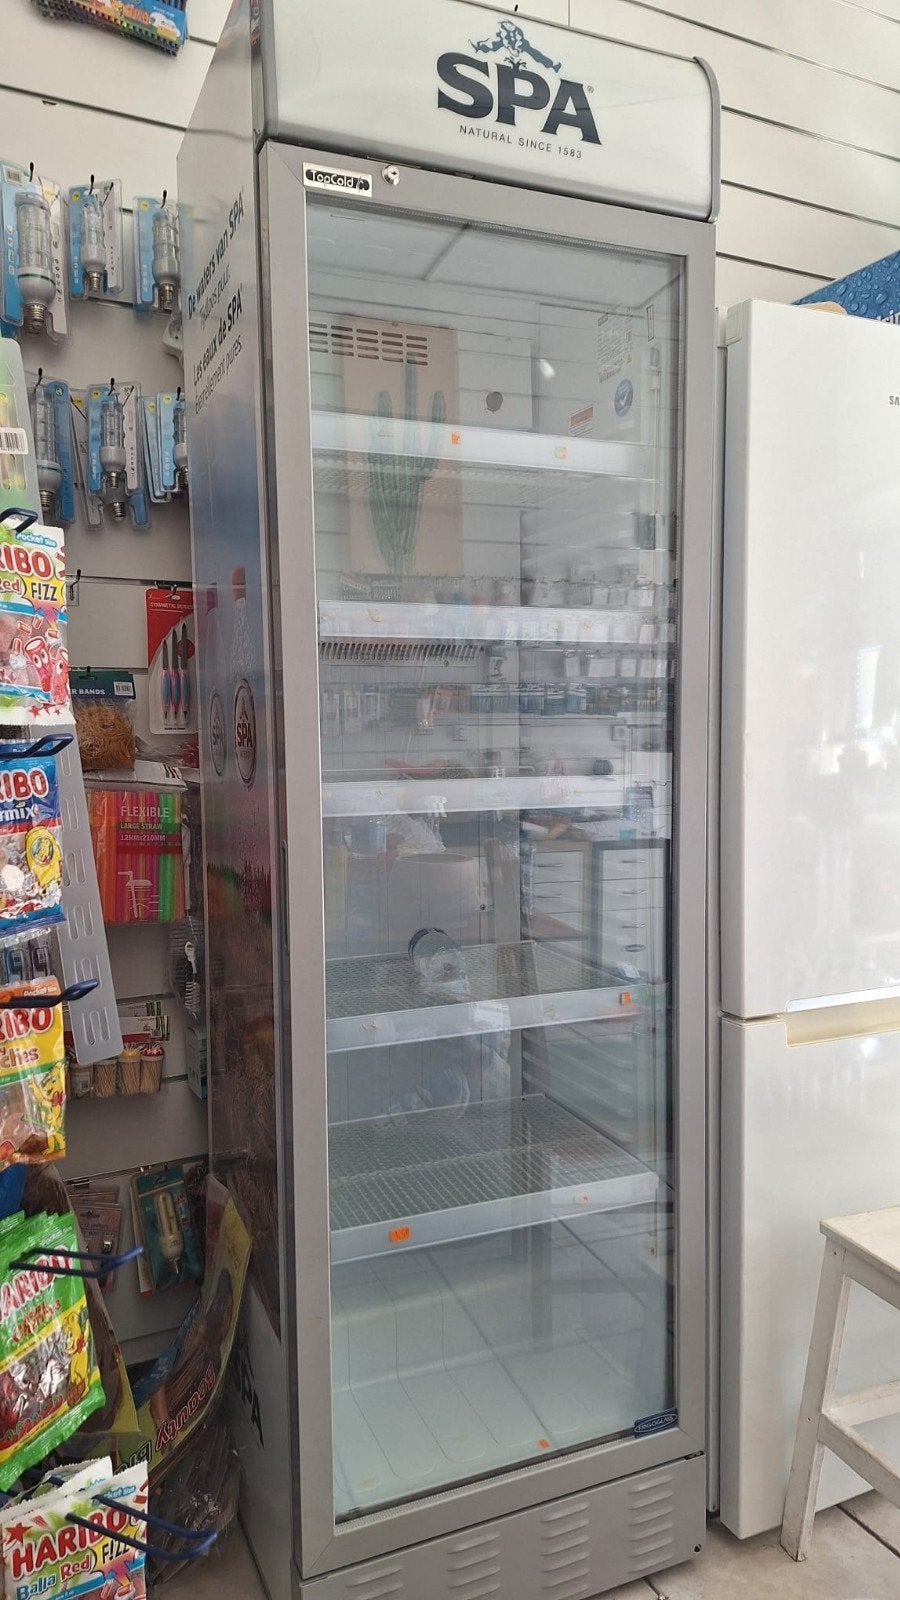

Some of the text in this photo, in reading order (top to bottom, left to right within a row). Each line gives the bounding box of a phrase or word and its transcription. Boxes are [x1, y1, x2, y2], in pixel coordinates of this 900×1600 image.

[437, 52, 602, 145] SPA
[459, 124, 583, 159] NATURAL SINCE 1583
[310, 169, 354, 188] TopCold
[188, 192, 244, 320] De waters van SPA
[193, 291, 243, 387] Les eaux de SPA
[225, 334, 243, 375] pures
[0, 544, 52, 579] IBO
[237, 721, 253, 748] SPA
[0, 769, 47, 801] IBO
[120, 806, 169, 818] FLEXIBLE
[120, 822, 163, 831] LARGE STRAW
[156, 1362, 216, 1450] Beauty
[60, 1553, 91, 1581] Red
